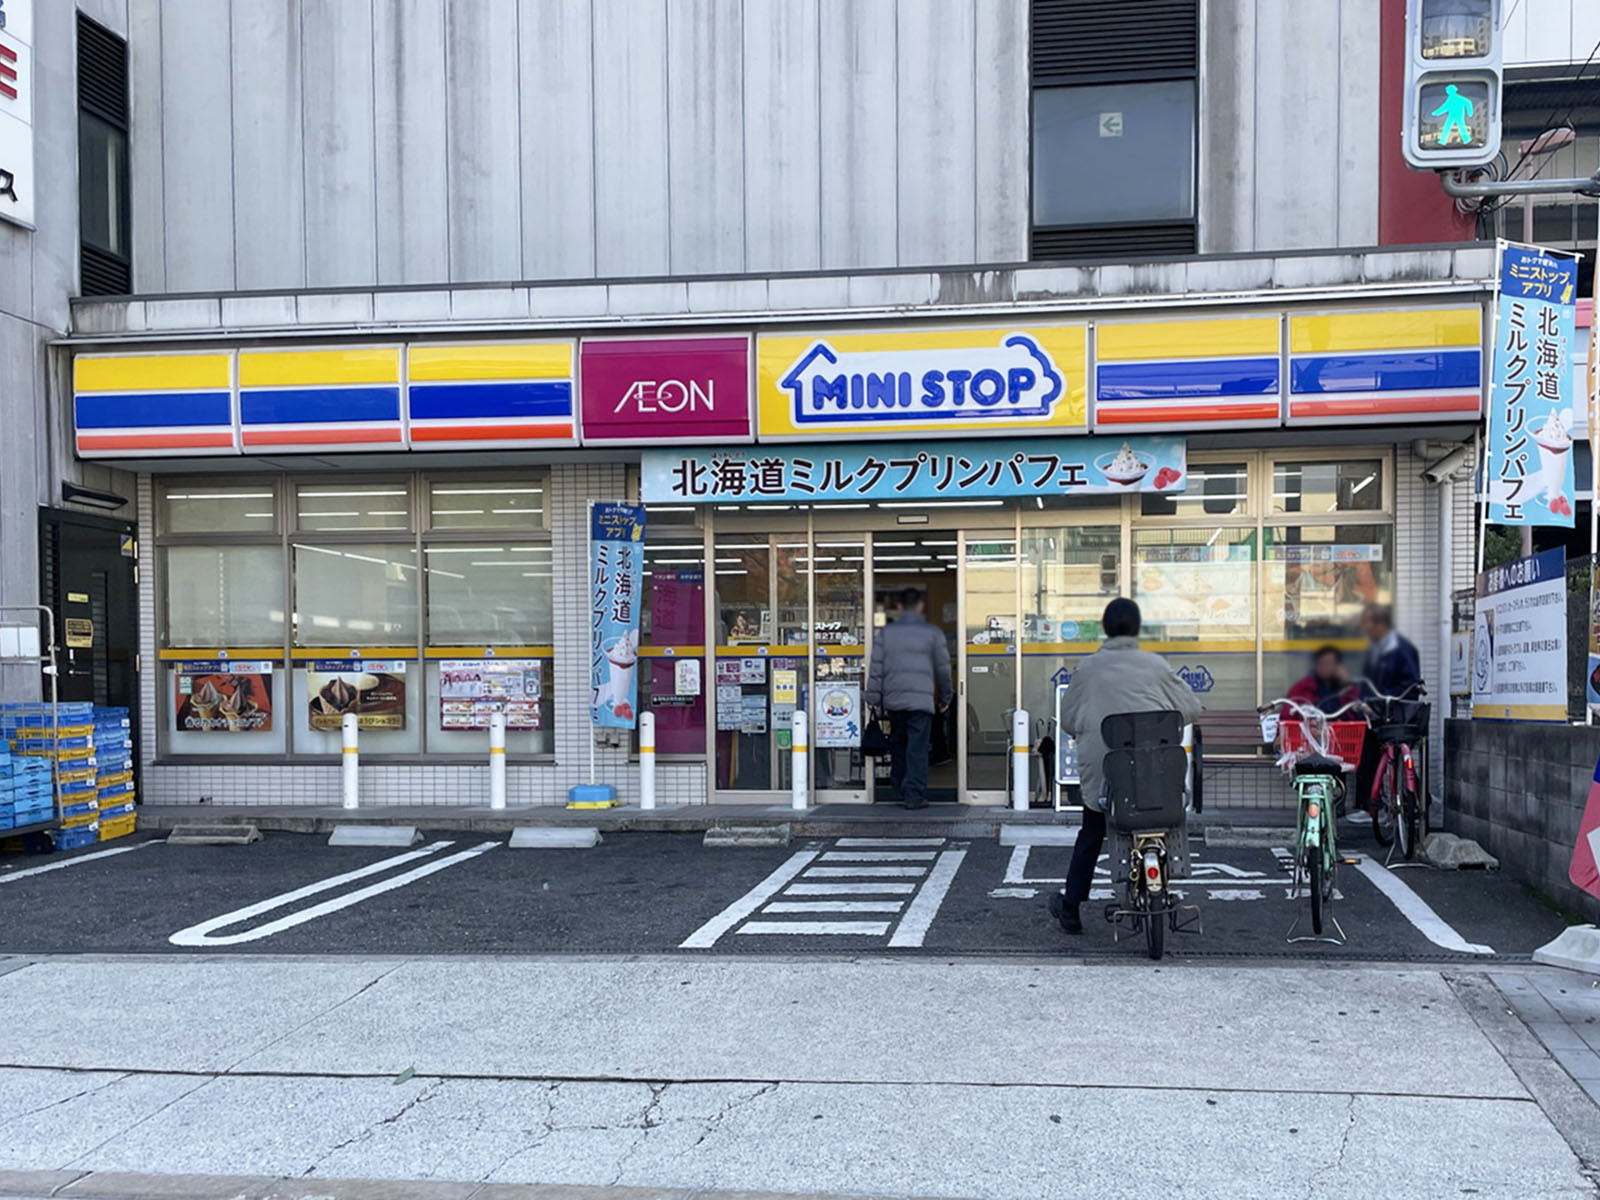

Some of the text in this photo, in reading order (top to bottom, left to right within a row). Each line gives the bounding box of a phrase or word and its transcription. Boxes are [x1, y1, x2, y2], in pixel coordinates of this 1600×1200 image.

[1509, 263, 1571, 285] ミニストップ
[1521, 281, 1553, 298] アプリ
[1536, 306, 1561, 401] 北海道
[812, 366, 1037, 410] MINI STOP
[1501, 302, 1531, 520] ミルクプリンパフェ
[672, 453, 1088, 496] 北海道ミルクプリンパフェ
[611, 545, 632, 624] 北海道
[1488, 559, 1541, 592] お客様へのお願い
